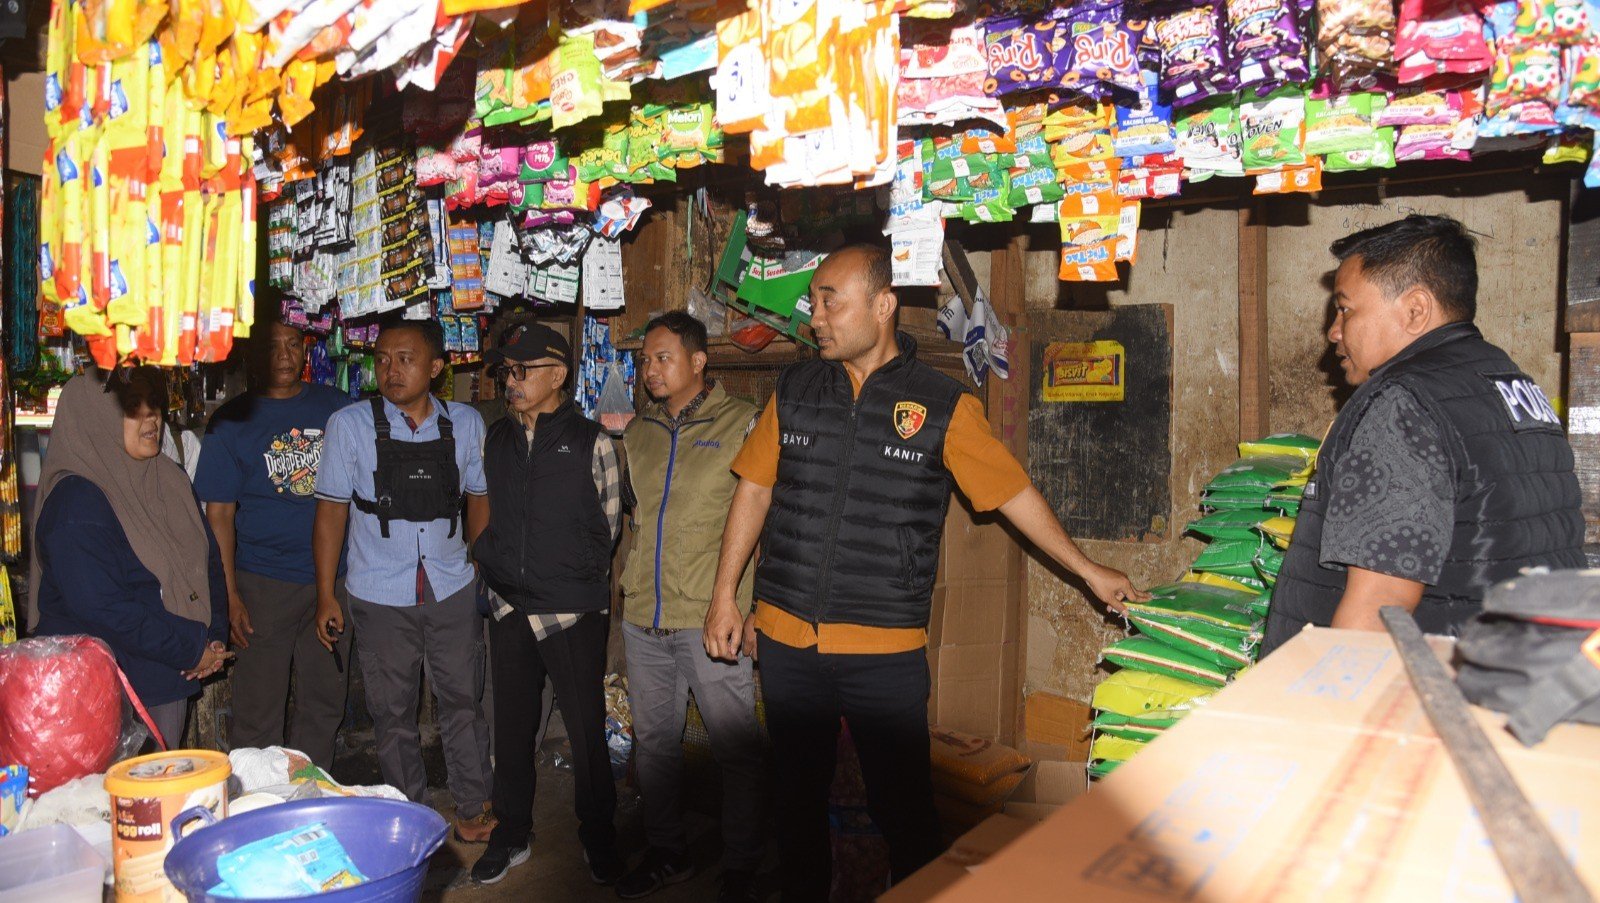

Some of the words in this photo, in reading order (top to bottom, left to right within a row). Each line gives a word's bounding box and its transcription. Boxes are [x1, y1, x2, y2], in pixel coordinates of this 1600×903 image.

[988, 33, 1042, 75] Ring
[1075, 31, 1133, 70] Ring
[667, 110, 702, 123] Melon
[783, 433, 810, 446] BAYU
[884, 446, 924, 462] KANIT
